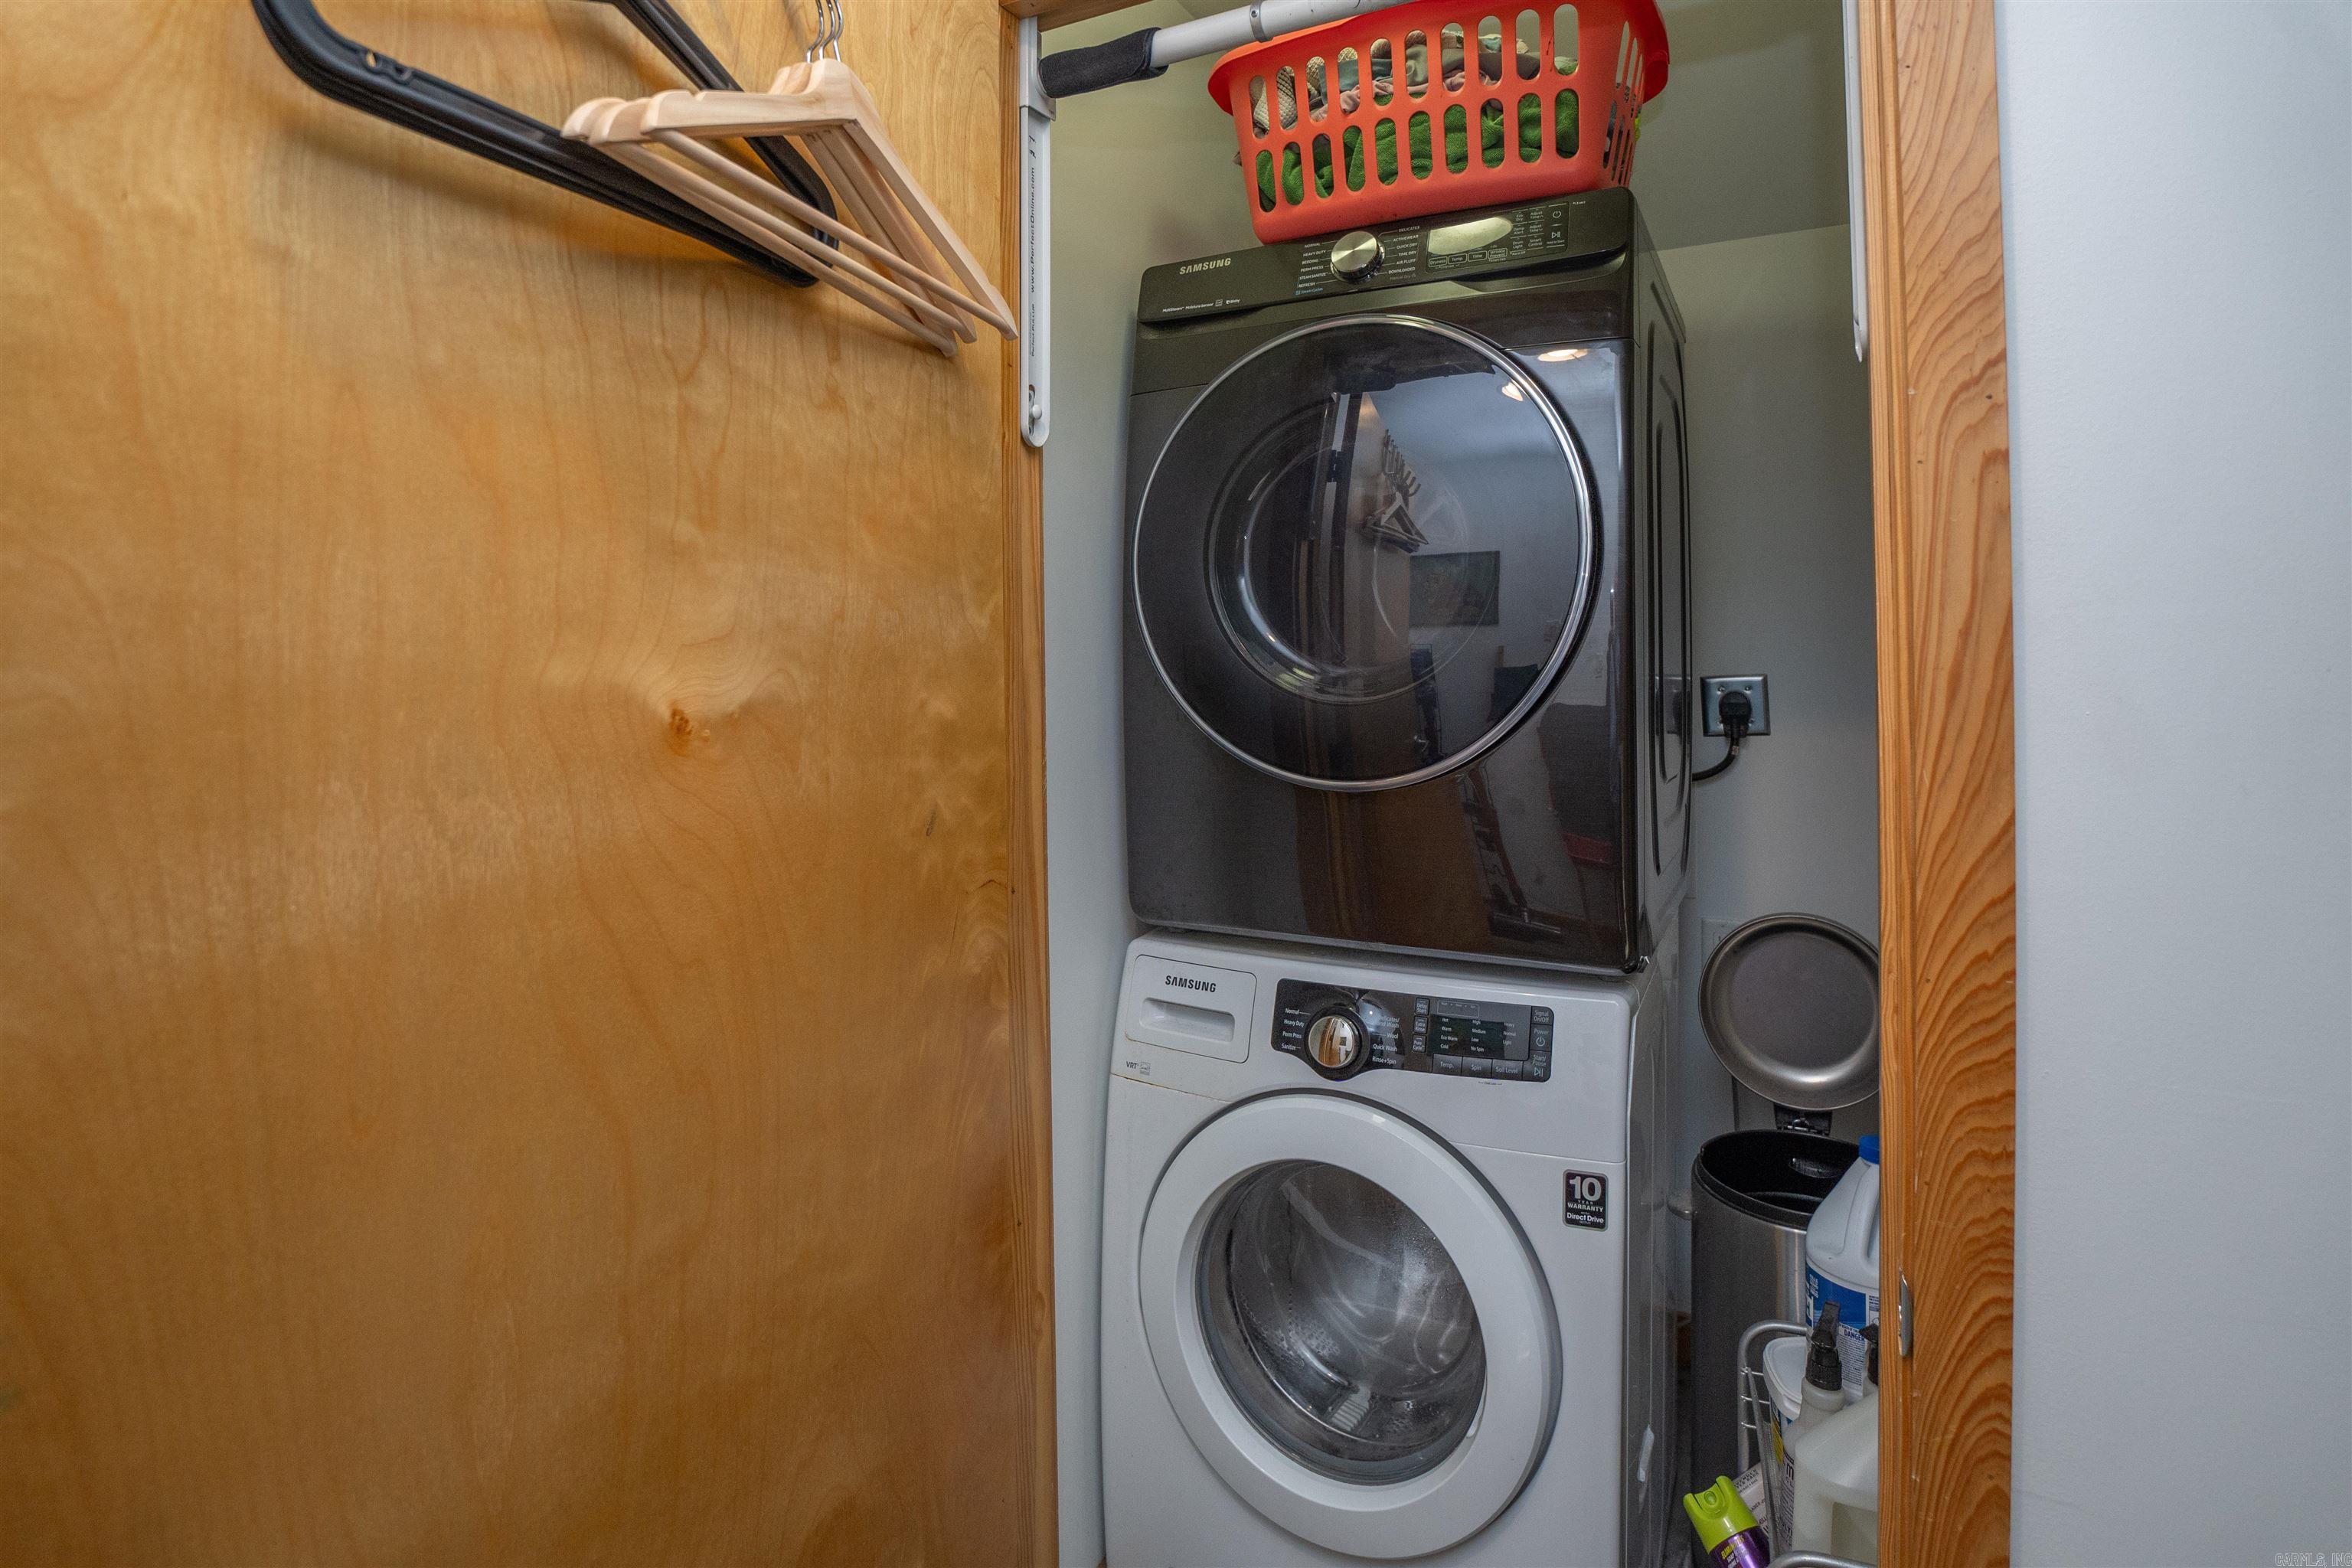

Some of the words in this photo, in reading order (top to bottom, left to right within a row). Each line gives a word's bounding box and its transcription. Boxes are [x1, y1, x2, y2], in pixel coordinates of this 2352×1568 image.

[1179, 257, 1231, 275] SAMSUNG
[1165, 975, 1217, 992] SAMSUNG
[1372, 1056, 1396, 1065] Rinse+Spin
[1570, 1176, 1602, 1201] 10
[1568, 1202, 1603, 1212] WARRANTY
[1587, 1214, 1604, 1223] Drive
[1844, 1329, 1865, 1341] DANGER
